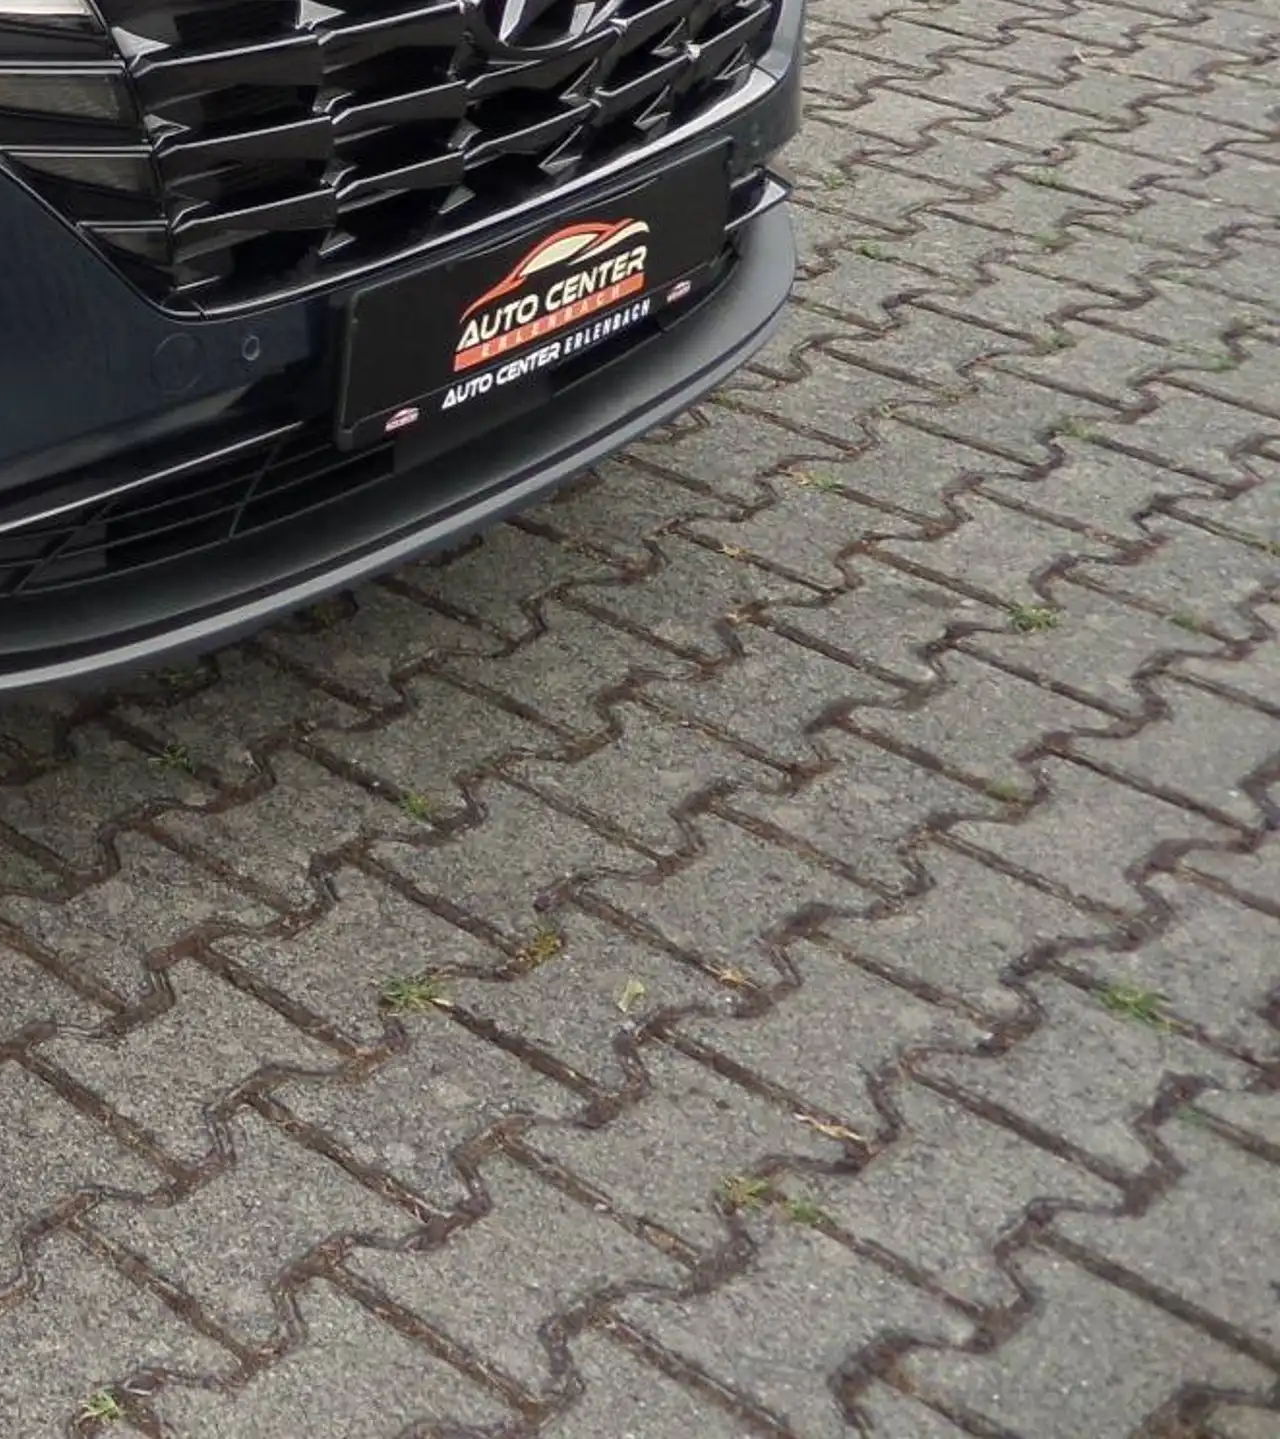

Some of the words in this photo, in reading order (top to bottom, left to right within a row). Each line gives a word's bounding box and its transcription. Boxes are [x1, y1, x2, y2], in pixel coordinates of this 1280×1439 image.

[456, 293, 539, 352] AUTO
[545, 245, 648, 311] CENTER
[442, 372, 494, 409] AUTO
[496, 341, 560, 385] CENTER
[563, 298, 651, 355] ERLENBACH
